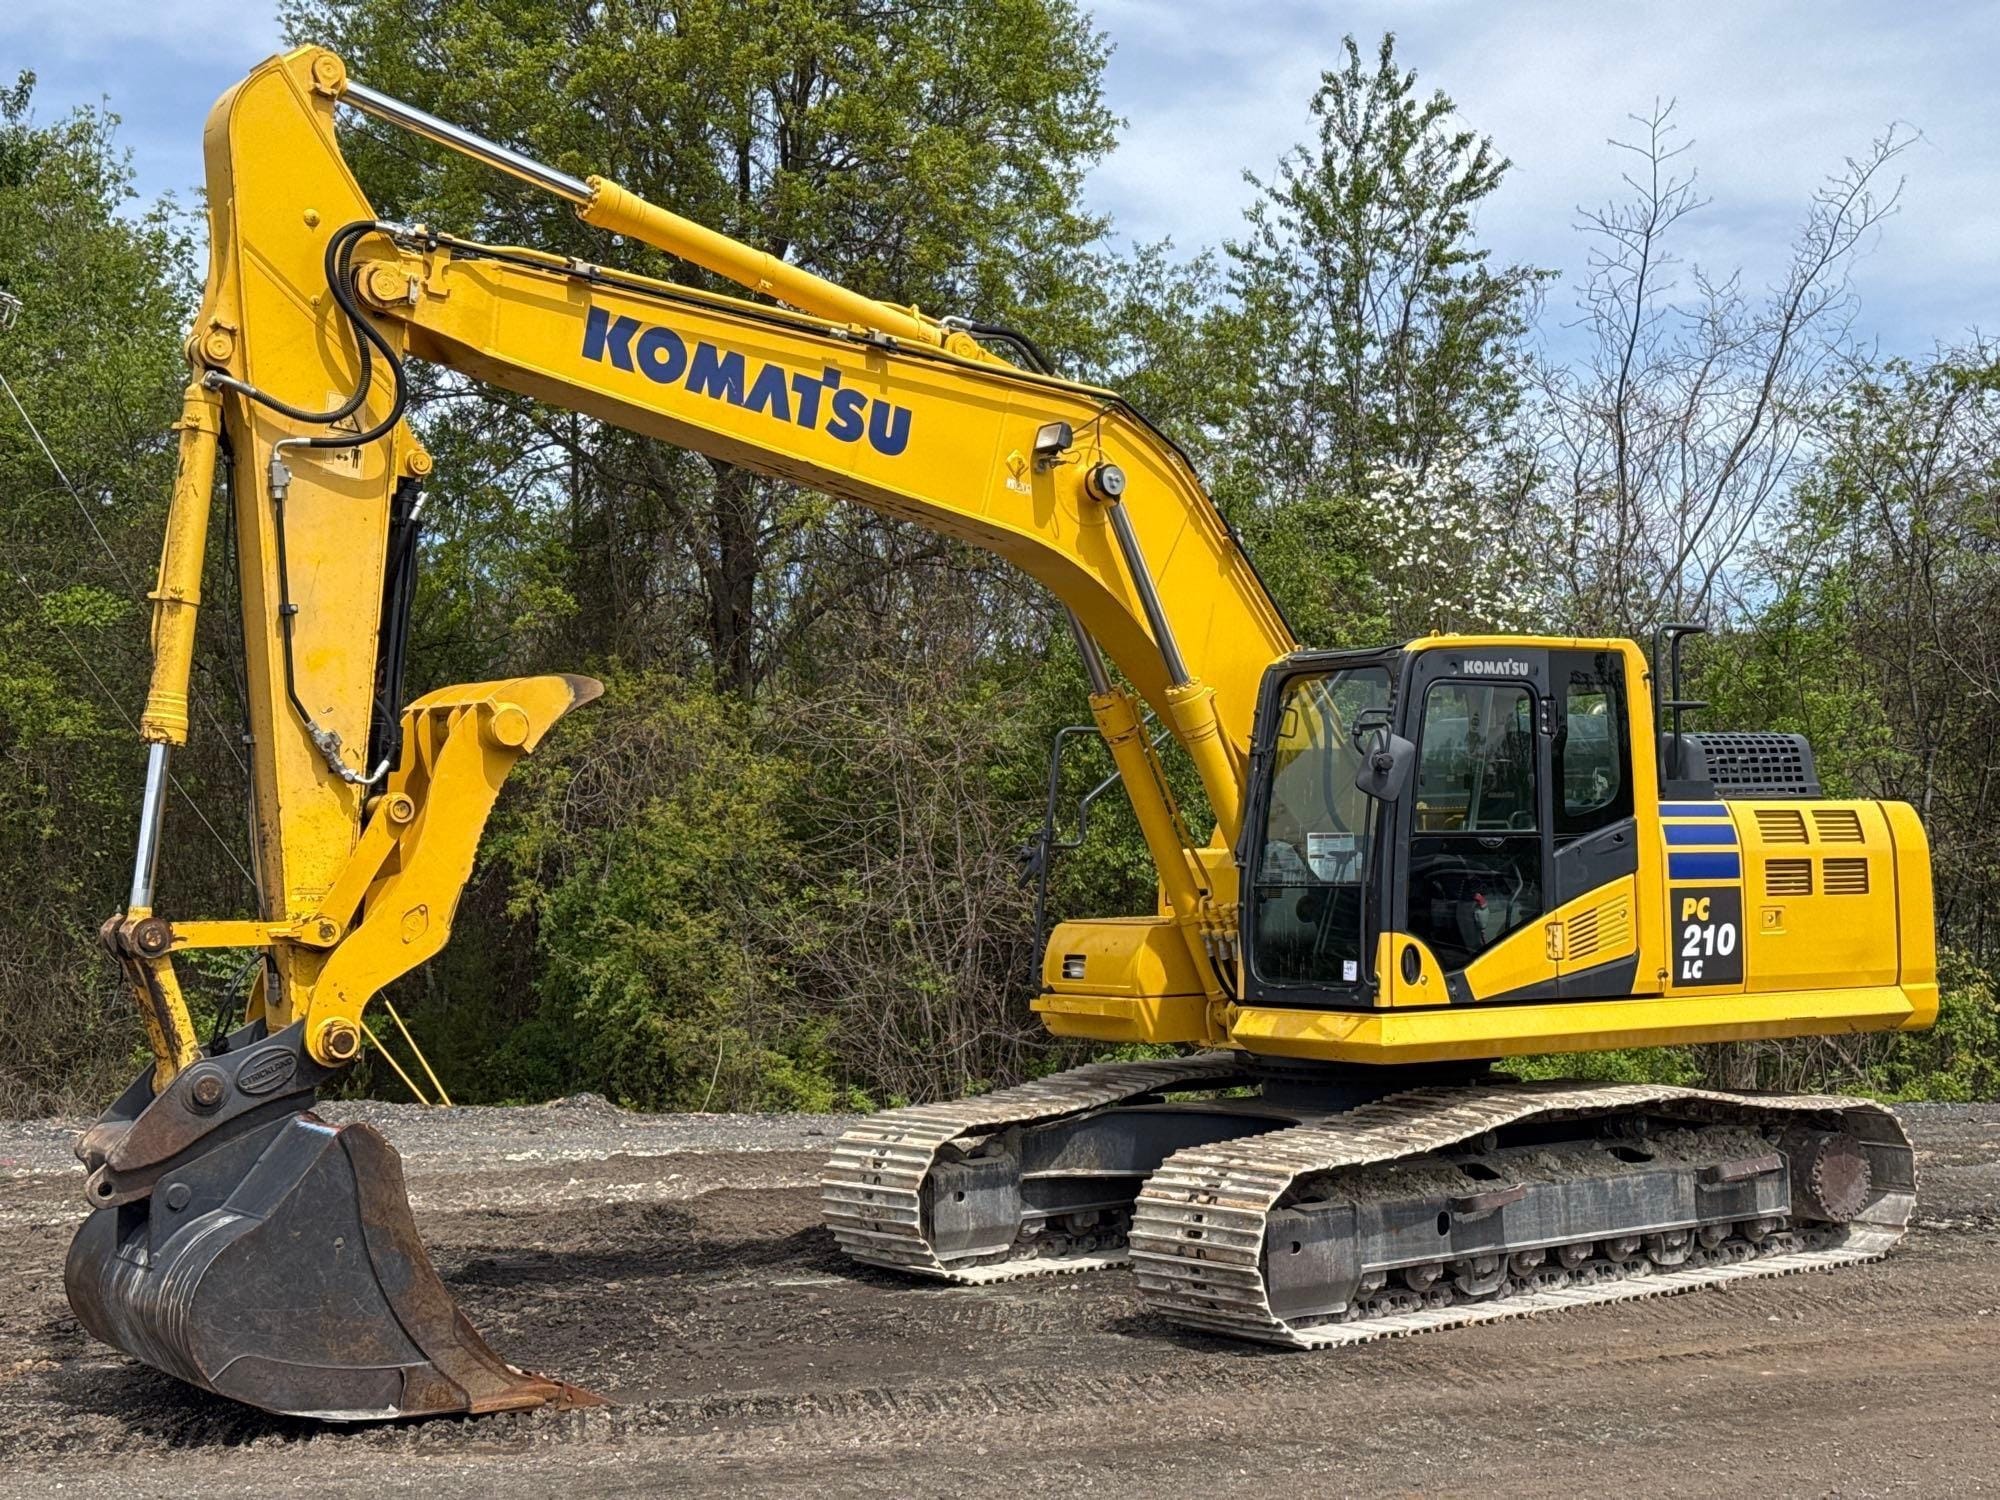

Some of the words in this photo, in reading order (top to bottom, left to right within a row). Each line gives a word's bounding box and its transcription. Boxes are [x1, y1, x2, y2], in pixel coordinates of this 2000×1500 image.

[582, 305, 912, 456] KOMATSU
[1463, 658, 1529, 676] KOMATSU
[1682, 897, 1711, 922] PC
[1682, 923, 1736, 957] 210
[1682, 960, 1704, 979] LC
[240, 1056, 294, 1087] STRICKLAND
